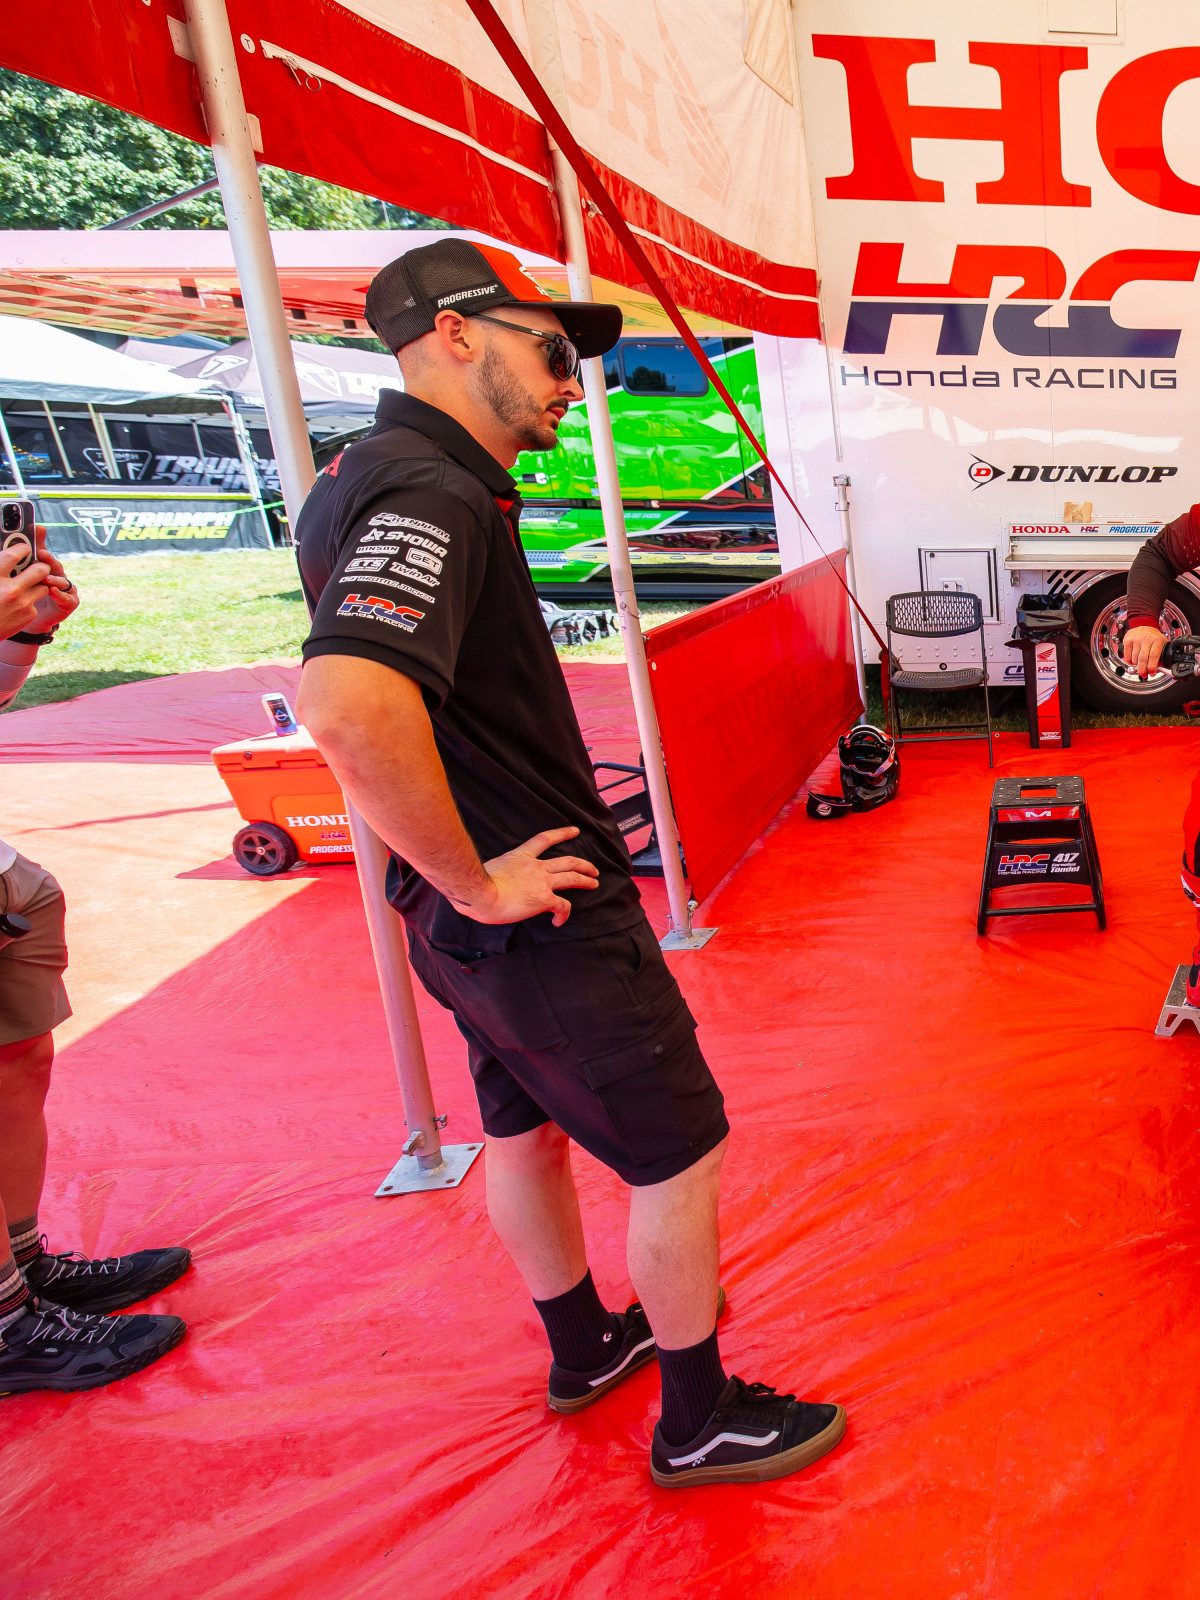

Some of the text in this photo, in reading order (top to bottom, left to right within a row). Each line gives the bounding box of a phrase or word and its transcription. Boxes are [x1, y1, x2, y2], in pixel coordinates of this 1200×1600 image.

[437, 285, 496, 309] PROGRESSIVE
[840, 365, 1177, 389] Honda RACING
[1006, 465, 1179, 483] DUNLOP
[121, 511, 237, 528] TRIUMPH
[116, 526, 230, 541] RACING
[1011, 525, 1071, 534] HONDA
[1109, 526, 1160, 534] PROGRESSIVE
[384, 531, 449, 558] SHOWA
[410, 553, 440, 570] GET
[337, 594, 425, 629] HRC
[375, 615, 415, 633] RACING
[998, 852, 1080, 872] HRC 417
[1051, 866, 1080, 874] Tondel
